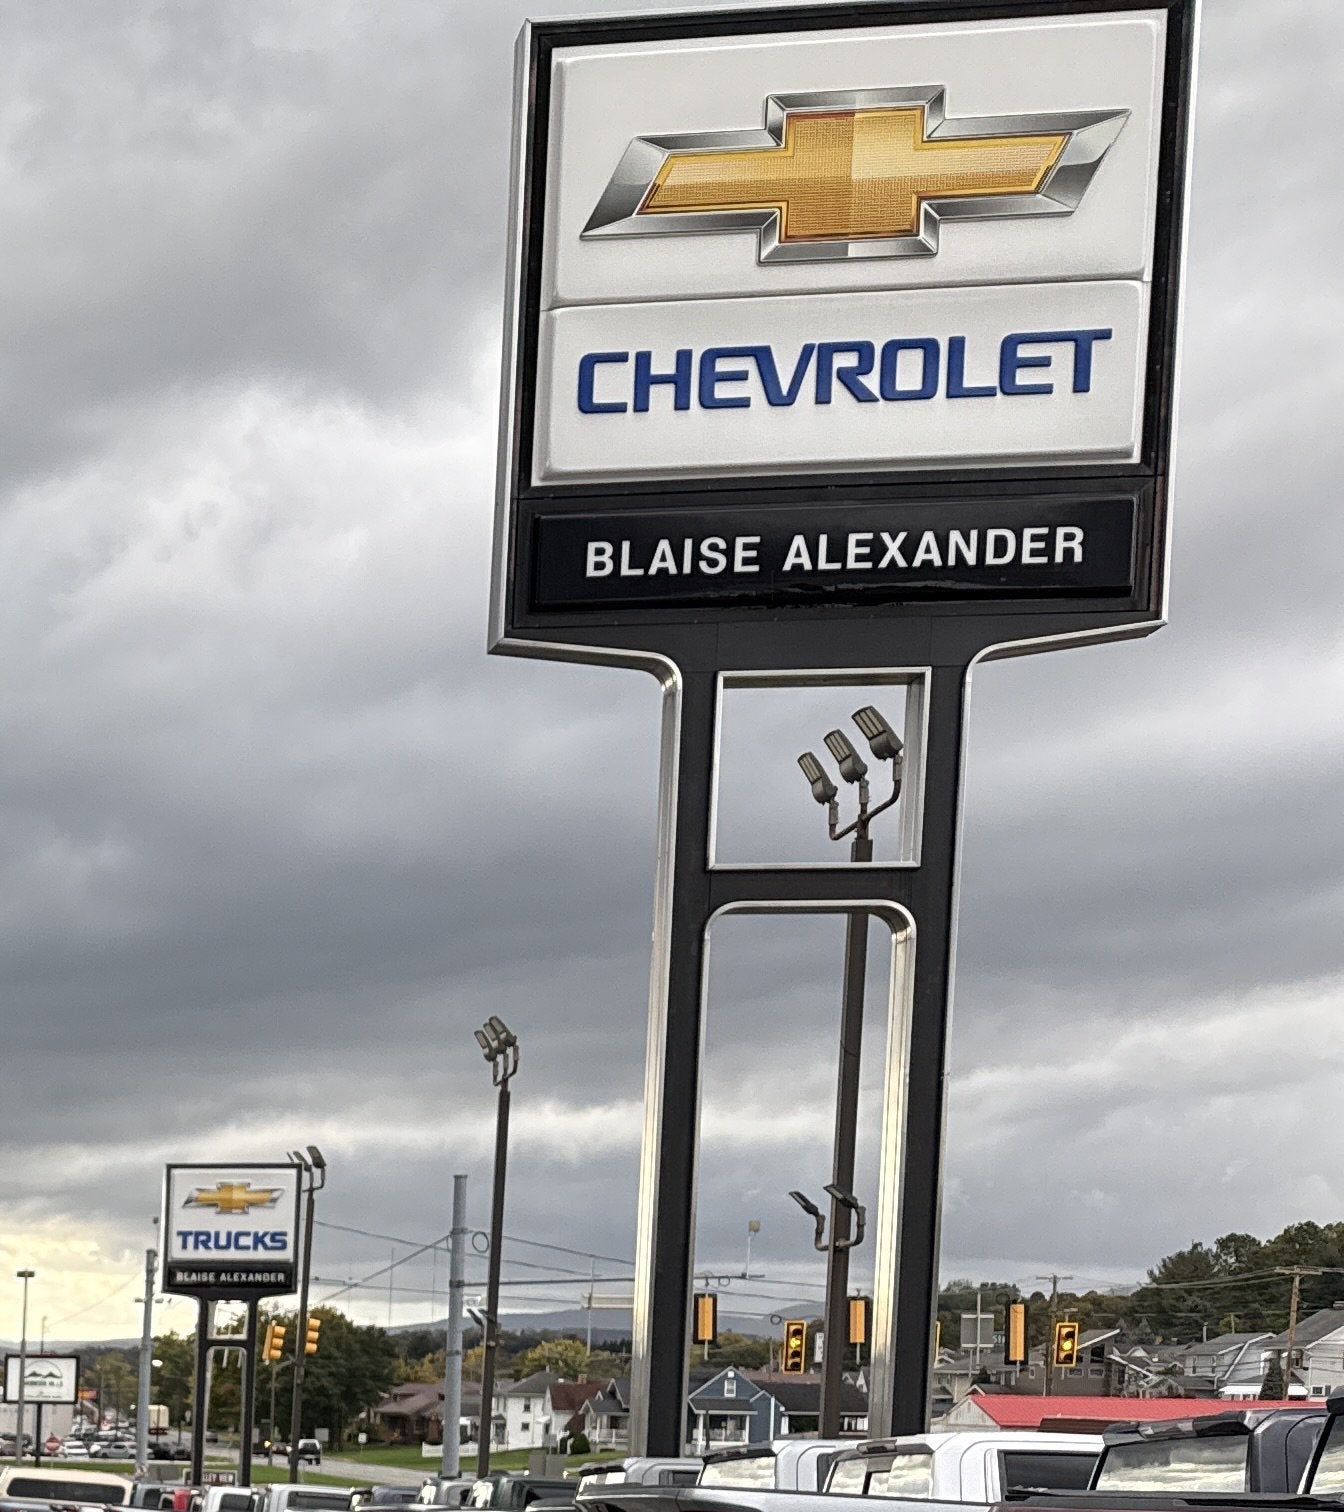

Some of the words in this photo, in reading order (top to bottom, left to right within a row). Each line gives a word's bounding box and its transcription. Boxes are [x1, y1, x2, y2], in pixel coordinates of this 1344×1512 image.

[577, 328, 1113, 414] CHEVROLET
[585, 535, 762, 578] BLAISE
[781, 525, 1085, 573] ALEXANDER
[176, 1230, 288, 1251] TRUCKS
[176, 1271, 216, 1282] BLAISE
[219, 1272, 285, 1283] ALEXANDER
